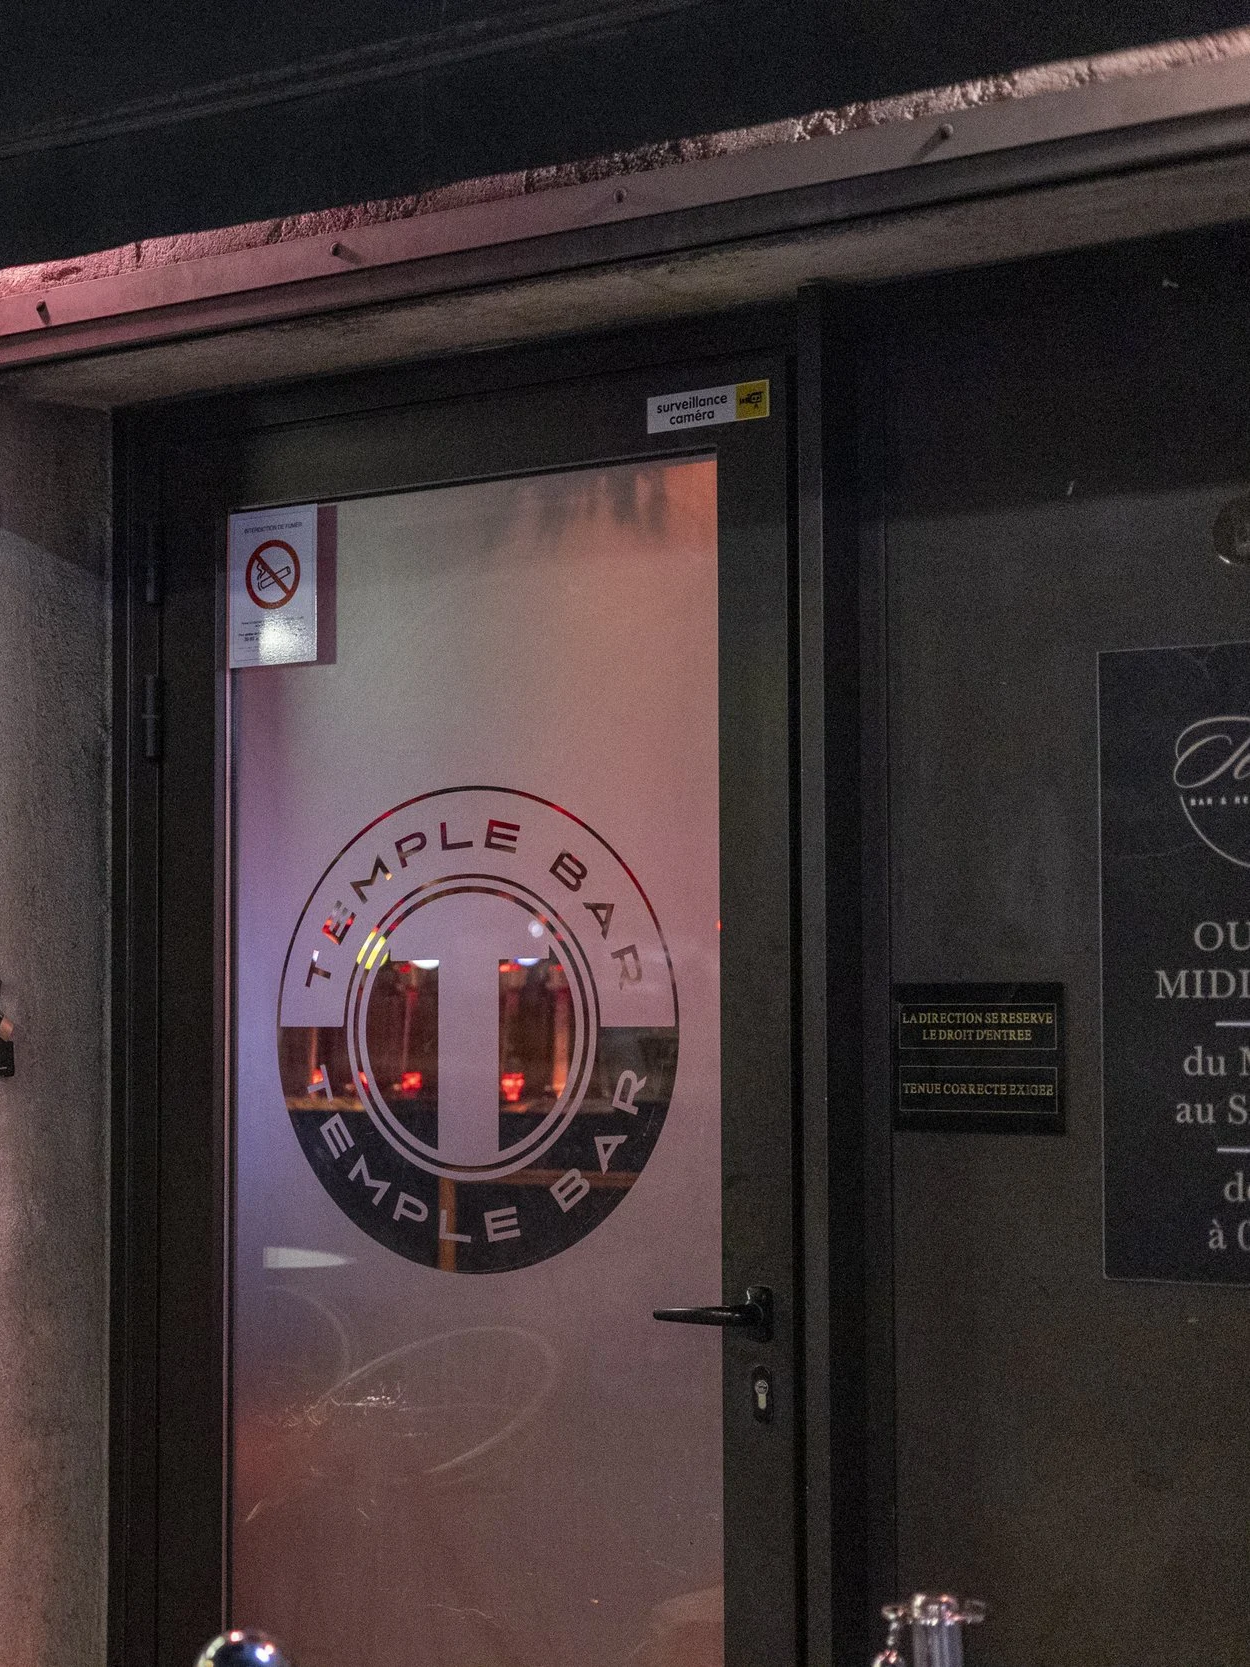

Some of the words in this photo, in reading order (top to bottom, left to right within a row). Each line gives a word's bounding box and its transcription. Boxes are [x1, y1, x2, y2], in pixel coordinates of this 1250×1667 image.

[656, 394, 728, 414] surveillance
[669, 410, 715, 425] caméra
[304, 819, 521, 988] TEMPLE
[549, 848, 643, 990] BAR
[1194, 921, 1250, 951] OU
[902, 1013, 917, 1023] LA
[919, 1013, 983, 1023] DIRECTION
[984, 1013, 999, 1023] SE
[1000, 1012, 1054, 1024] RESERVE
[922, 1030, 937, 1040] LE
[938, 1030, 974, 1040] DROIT
[976, 1029, 1032, 1041] D'ENTREE
[1183, 1046, 1227, 1076] du
[902, 1083, 941, 1094] TENUE
[943, 1083, 1007, 1095] CORRECTE
[1009, 1084, 1054, 1096] EXIGEE
[1176, 1103, 1216, 1124] au
[307, 1064, 522, 1243] TEMPLE
[550, 1069, 647, 1213] BAR
[1223, 1172, 1250, 1202] d
[1209, 1219, 1227, 1249] à
